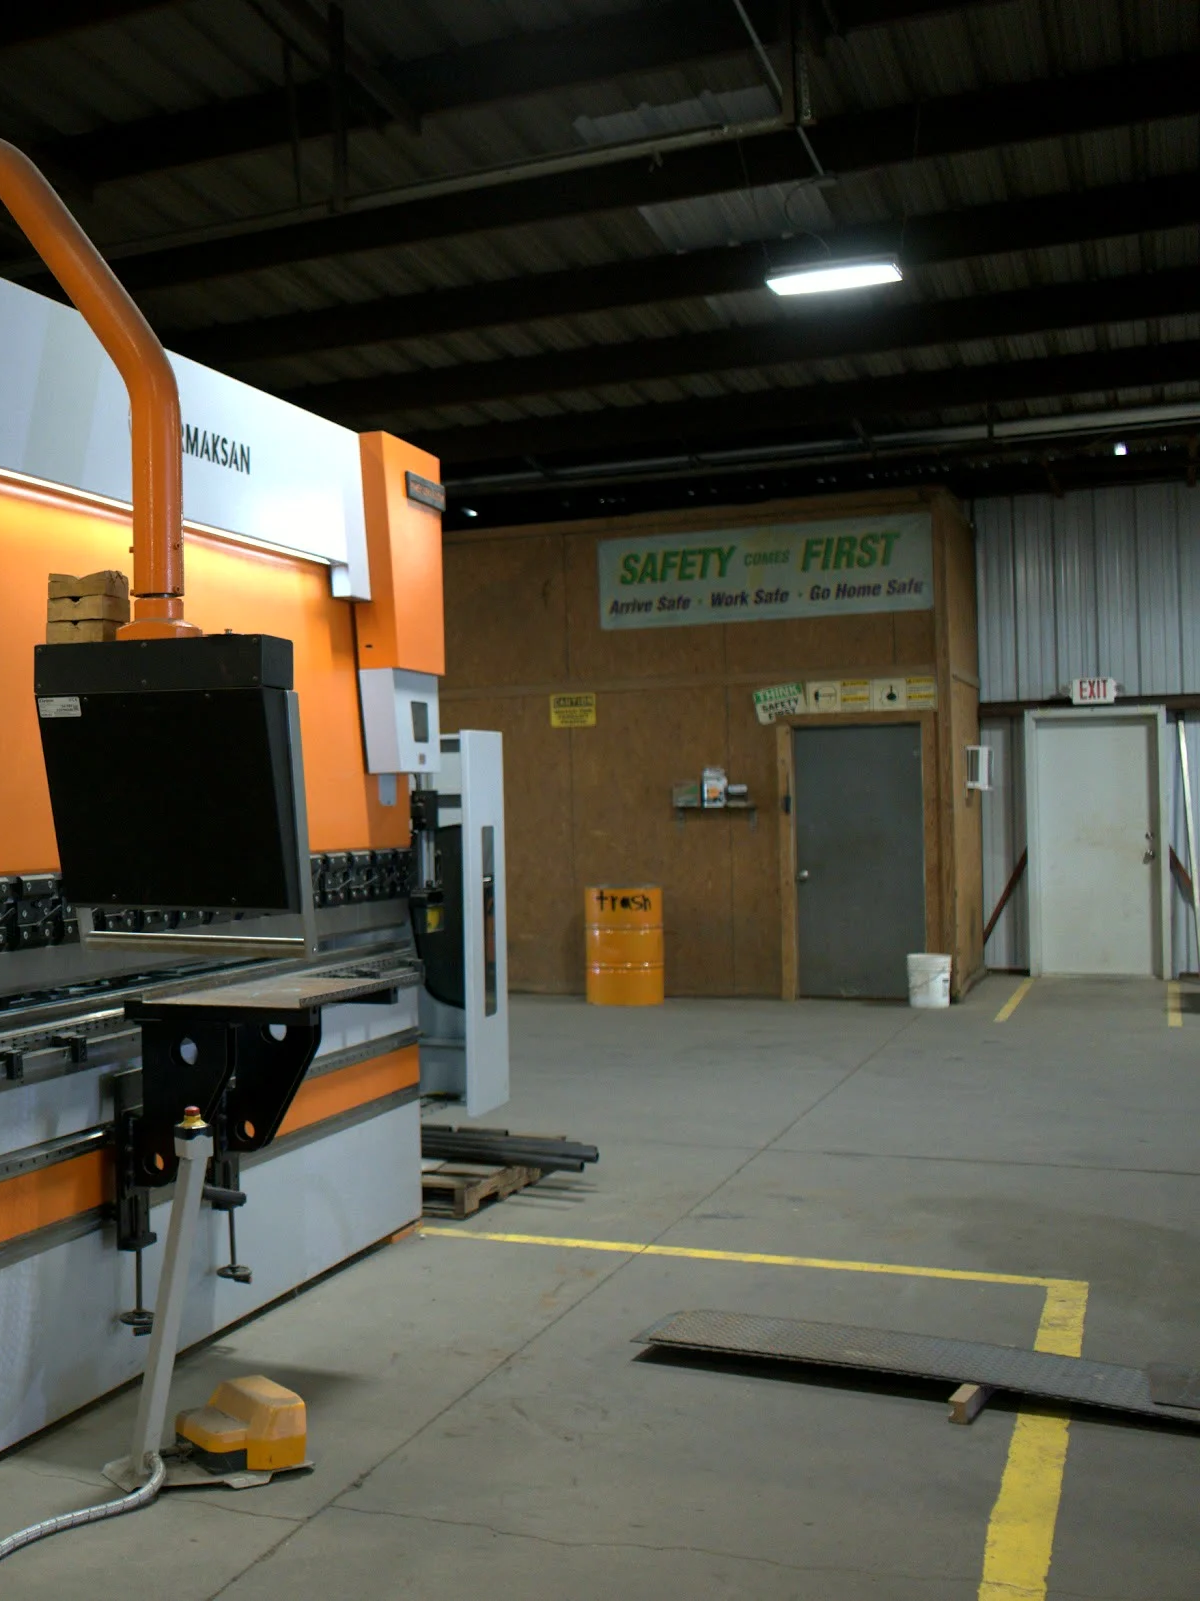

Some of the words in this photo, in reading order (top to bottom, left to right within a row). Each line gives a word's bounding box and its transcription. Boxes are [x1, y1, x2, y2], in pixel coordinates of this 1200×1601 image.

[620, 546, 736, 585] SAFETY
[744, 550, 790, 567] COMES
[801, 532, 901, 572] FIRST
[609, 599, 653, 615] Arrive
[657, 595, 691, 612] Safe
[711, 591, 749, 607] Work
[754, 588, 790, 605] Safe
[810, 585, 831, 601] Go
[836, 583, 882, 600] Home
[886, 578, 924, 595] Safe
[1079, 680, 1107, 699] EXIT
[762, 697, 799, 713] SAFETY
[596, 890, 652, 912] trash
